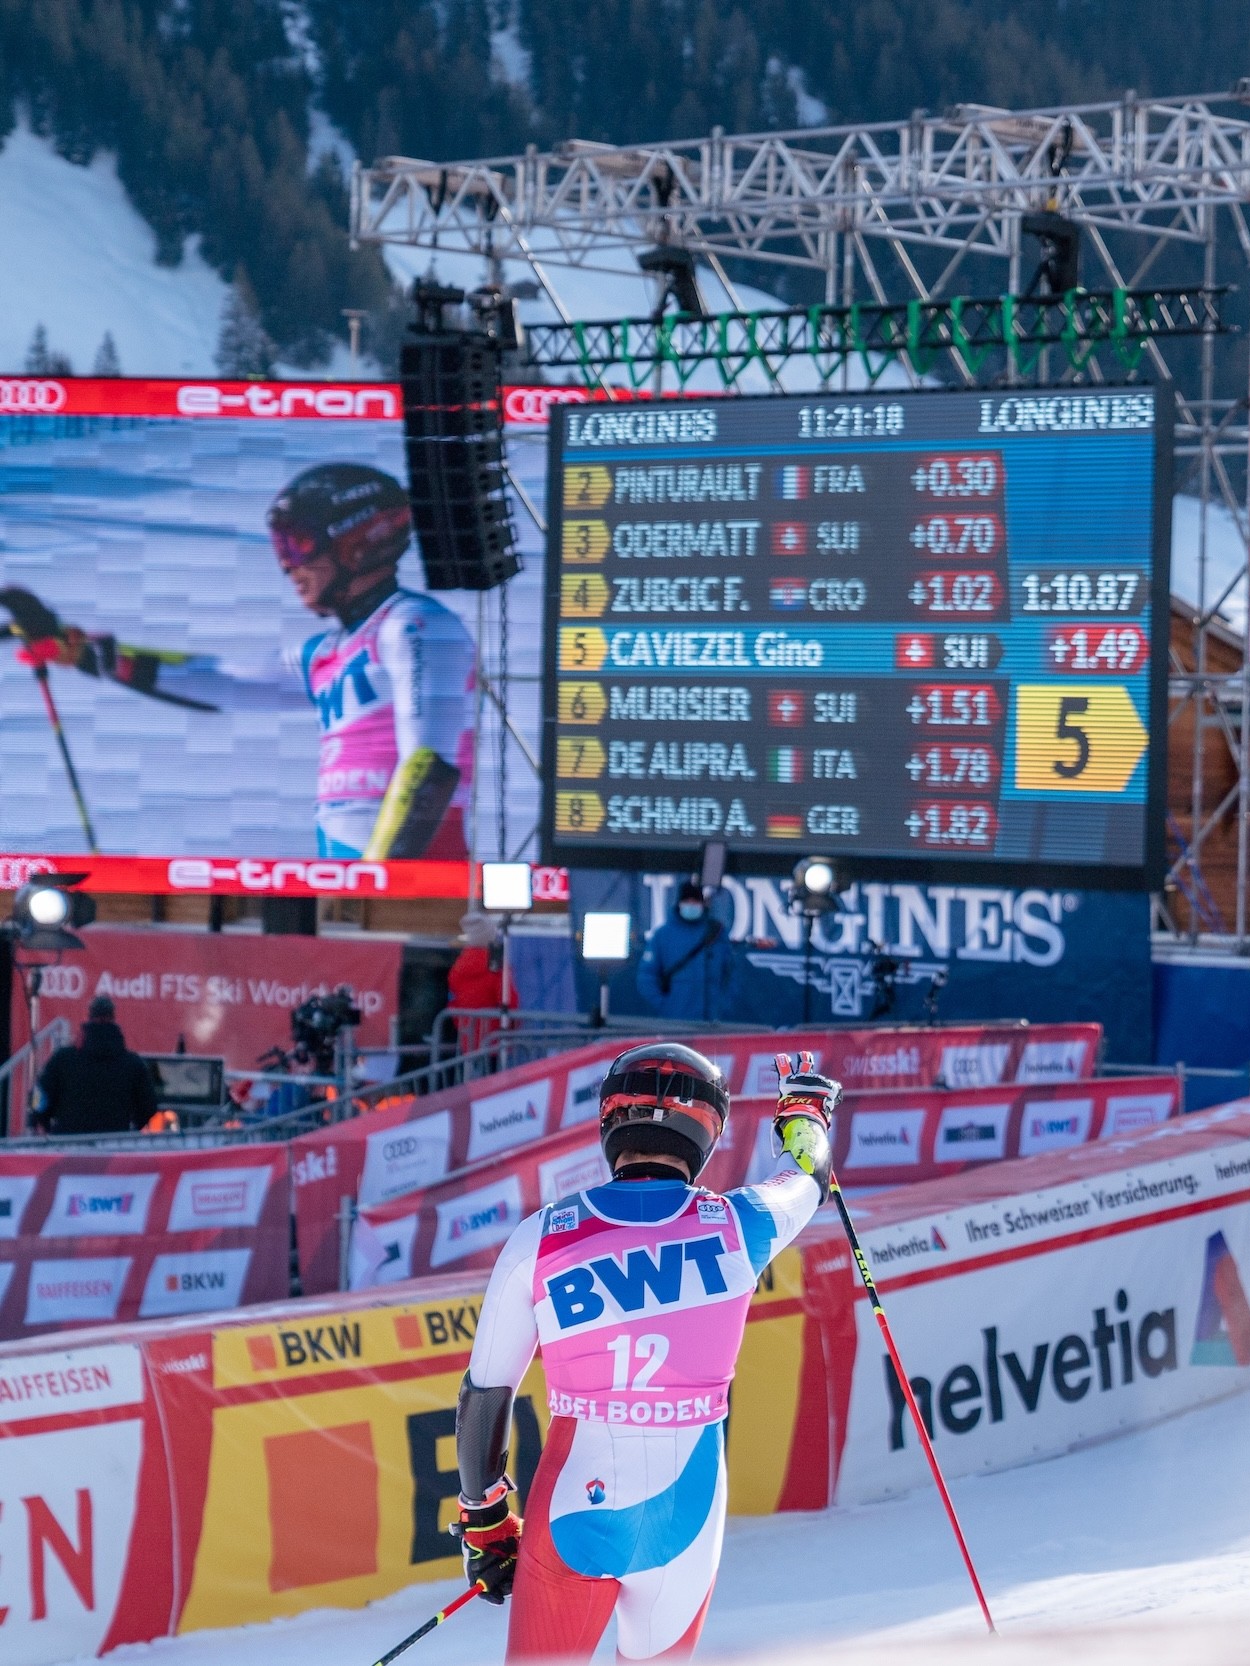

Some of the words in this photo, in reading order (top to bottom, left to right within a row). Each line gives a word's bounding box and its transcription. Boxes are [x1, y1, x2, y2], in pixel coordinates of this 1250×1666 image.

[177, 386, 395, 416] e-tron
[978, 394, 1155, 432] LONGINES
[566, 409, 718, 446] LONGINES
[577, 471, 592, 501] 2
[614, 463, 762, 503] PINTURAULT
[814, 464, 866, 493] FRA
[910, 458, 997, 496] +0.30
[577, 525, 590, 558] 3
[612, 519, 762, 558] ODERMATT
[816, 521, 860, 555] SUI
[909, 515, 995, 553] +0.70
[575, 580, 589, 611] 4
[808, 578, 867, 611] CRO
[908, 575, 993, 611] +1.02
[1022, 573, 1139, 611] 1:10.87
[575, 632, 587, 665] 5
[610, 631, 752, 667] CAVIEZEL
[755, 631, 824, 667] Gino
[944, 634, 989, 668] SUI
[1049, 628, 1140, 669] +1.49
[571, 686, 586, 720] 6
[610, 685, 752, 721] MURISIER
[814, 693, 857, 722] SUI
[905, 690, 991, 725] +1.51
[1053, 697, 1090, 778] 5
[569, 744, 586, 774] 7
[608, 740, 647, 779] DE
[813, 749, 857, 779] ITA
[905, 748, 991, 787] +1.78
[569, 797, 584, 828] 8
[607, 795, 723, 835] SCHMID
[807, 805, 860, 835] GER
[168, 858, 387, 891] e-tron
[95, 971, 155, 999] Audi
[160, 974, 201, 1002] FIS
[206, 976, 243, 1005] Ski
[333, 984, 383, 1015] up
[479, 1109, 523, 1135] helvetia
[870, 1236, 930, 1264] helvetia
[964, 1219, 1001, 1243] Ihre
[1003, 1200, 1091, 1234] Schweizer
[181, 1272, 226, 1292] BKW
[547, 1236, 728, 1329] BWT
[854, 1249, 876, 1288] LEKI
[279, 1322, 361, 1367] BKW
[607, 1333, 670, 1392] 12
[882, 1288, 1178, 1451] helvetia
[549, 1388, 711, 1424] ADELBODEN
